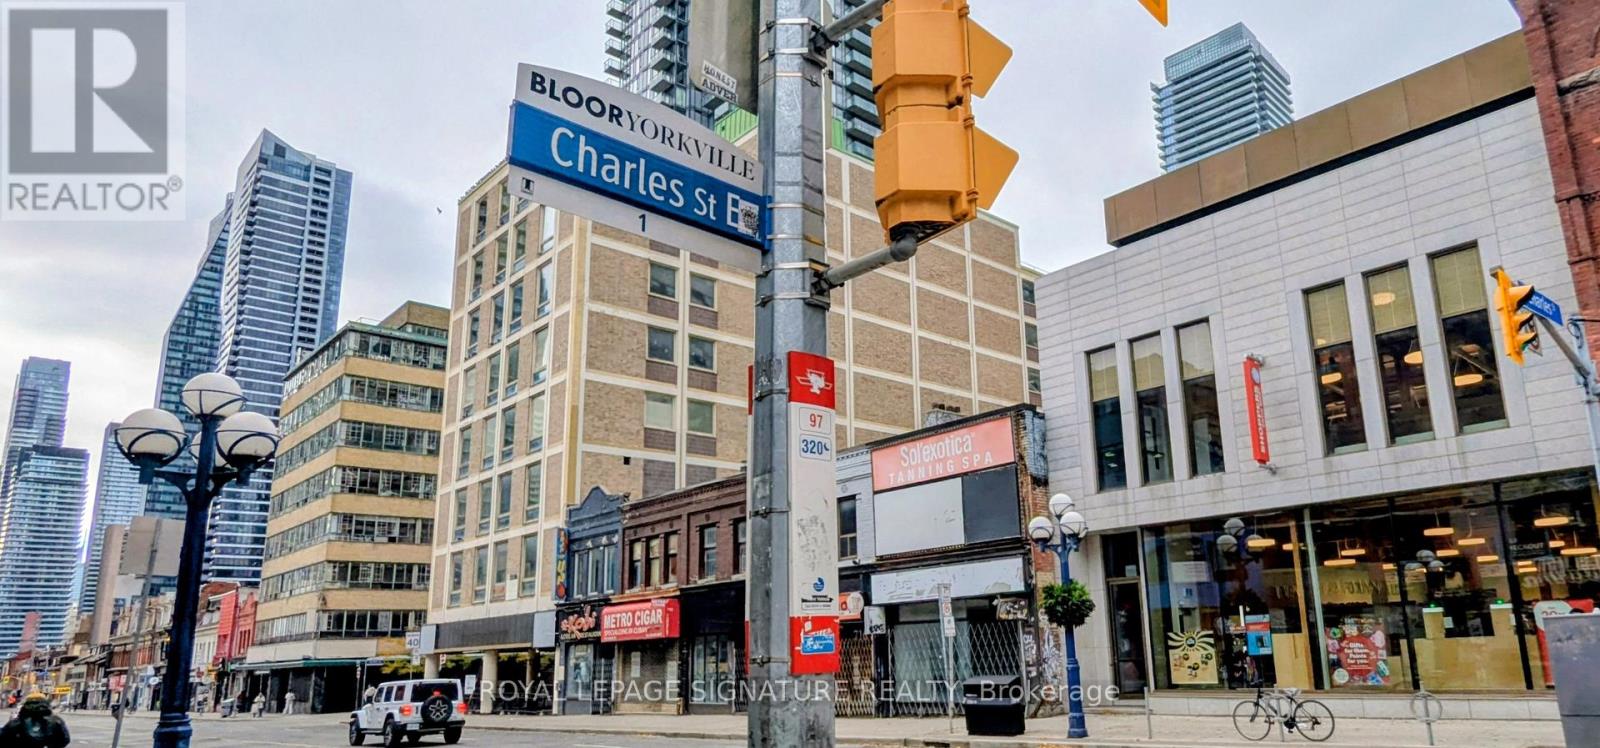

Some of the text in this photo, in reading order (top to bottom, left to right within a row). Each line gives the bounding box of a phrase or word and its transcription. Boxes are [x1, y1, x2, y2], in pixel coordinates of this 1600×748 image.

[551, 127, 685, 208] Charles
[694, 187, 717, 221] St
[638, 213, 647, 232] 1
[809, 413, 823, 429] 97
[801, 439, 823, 455] 320
[888, 451, 993, 485] TANNING SPA
[604, 613, 633, 629] METRO
[634, 608, 663, 626] CIGAR
[407, 639, 419, 647] 40
